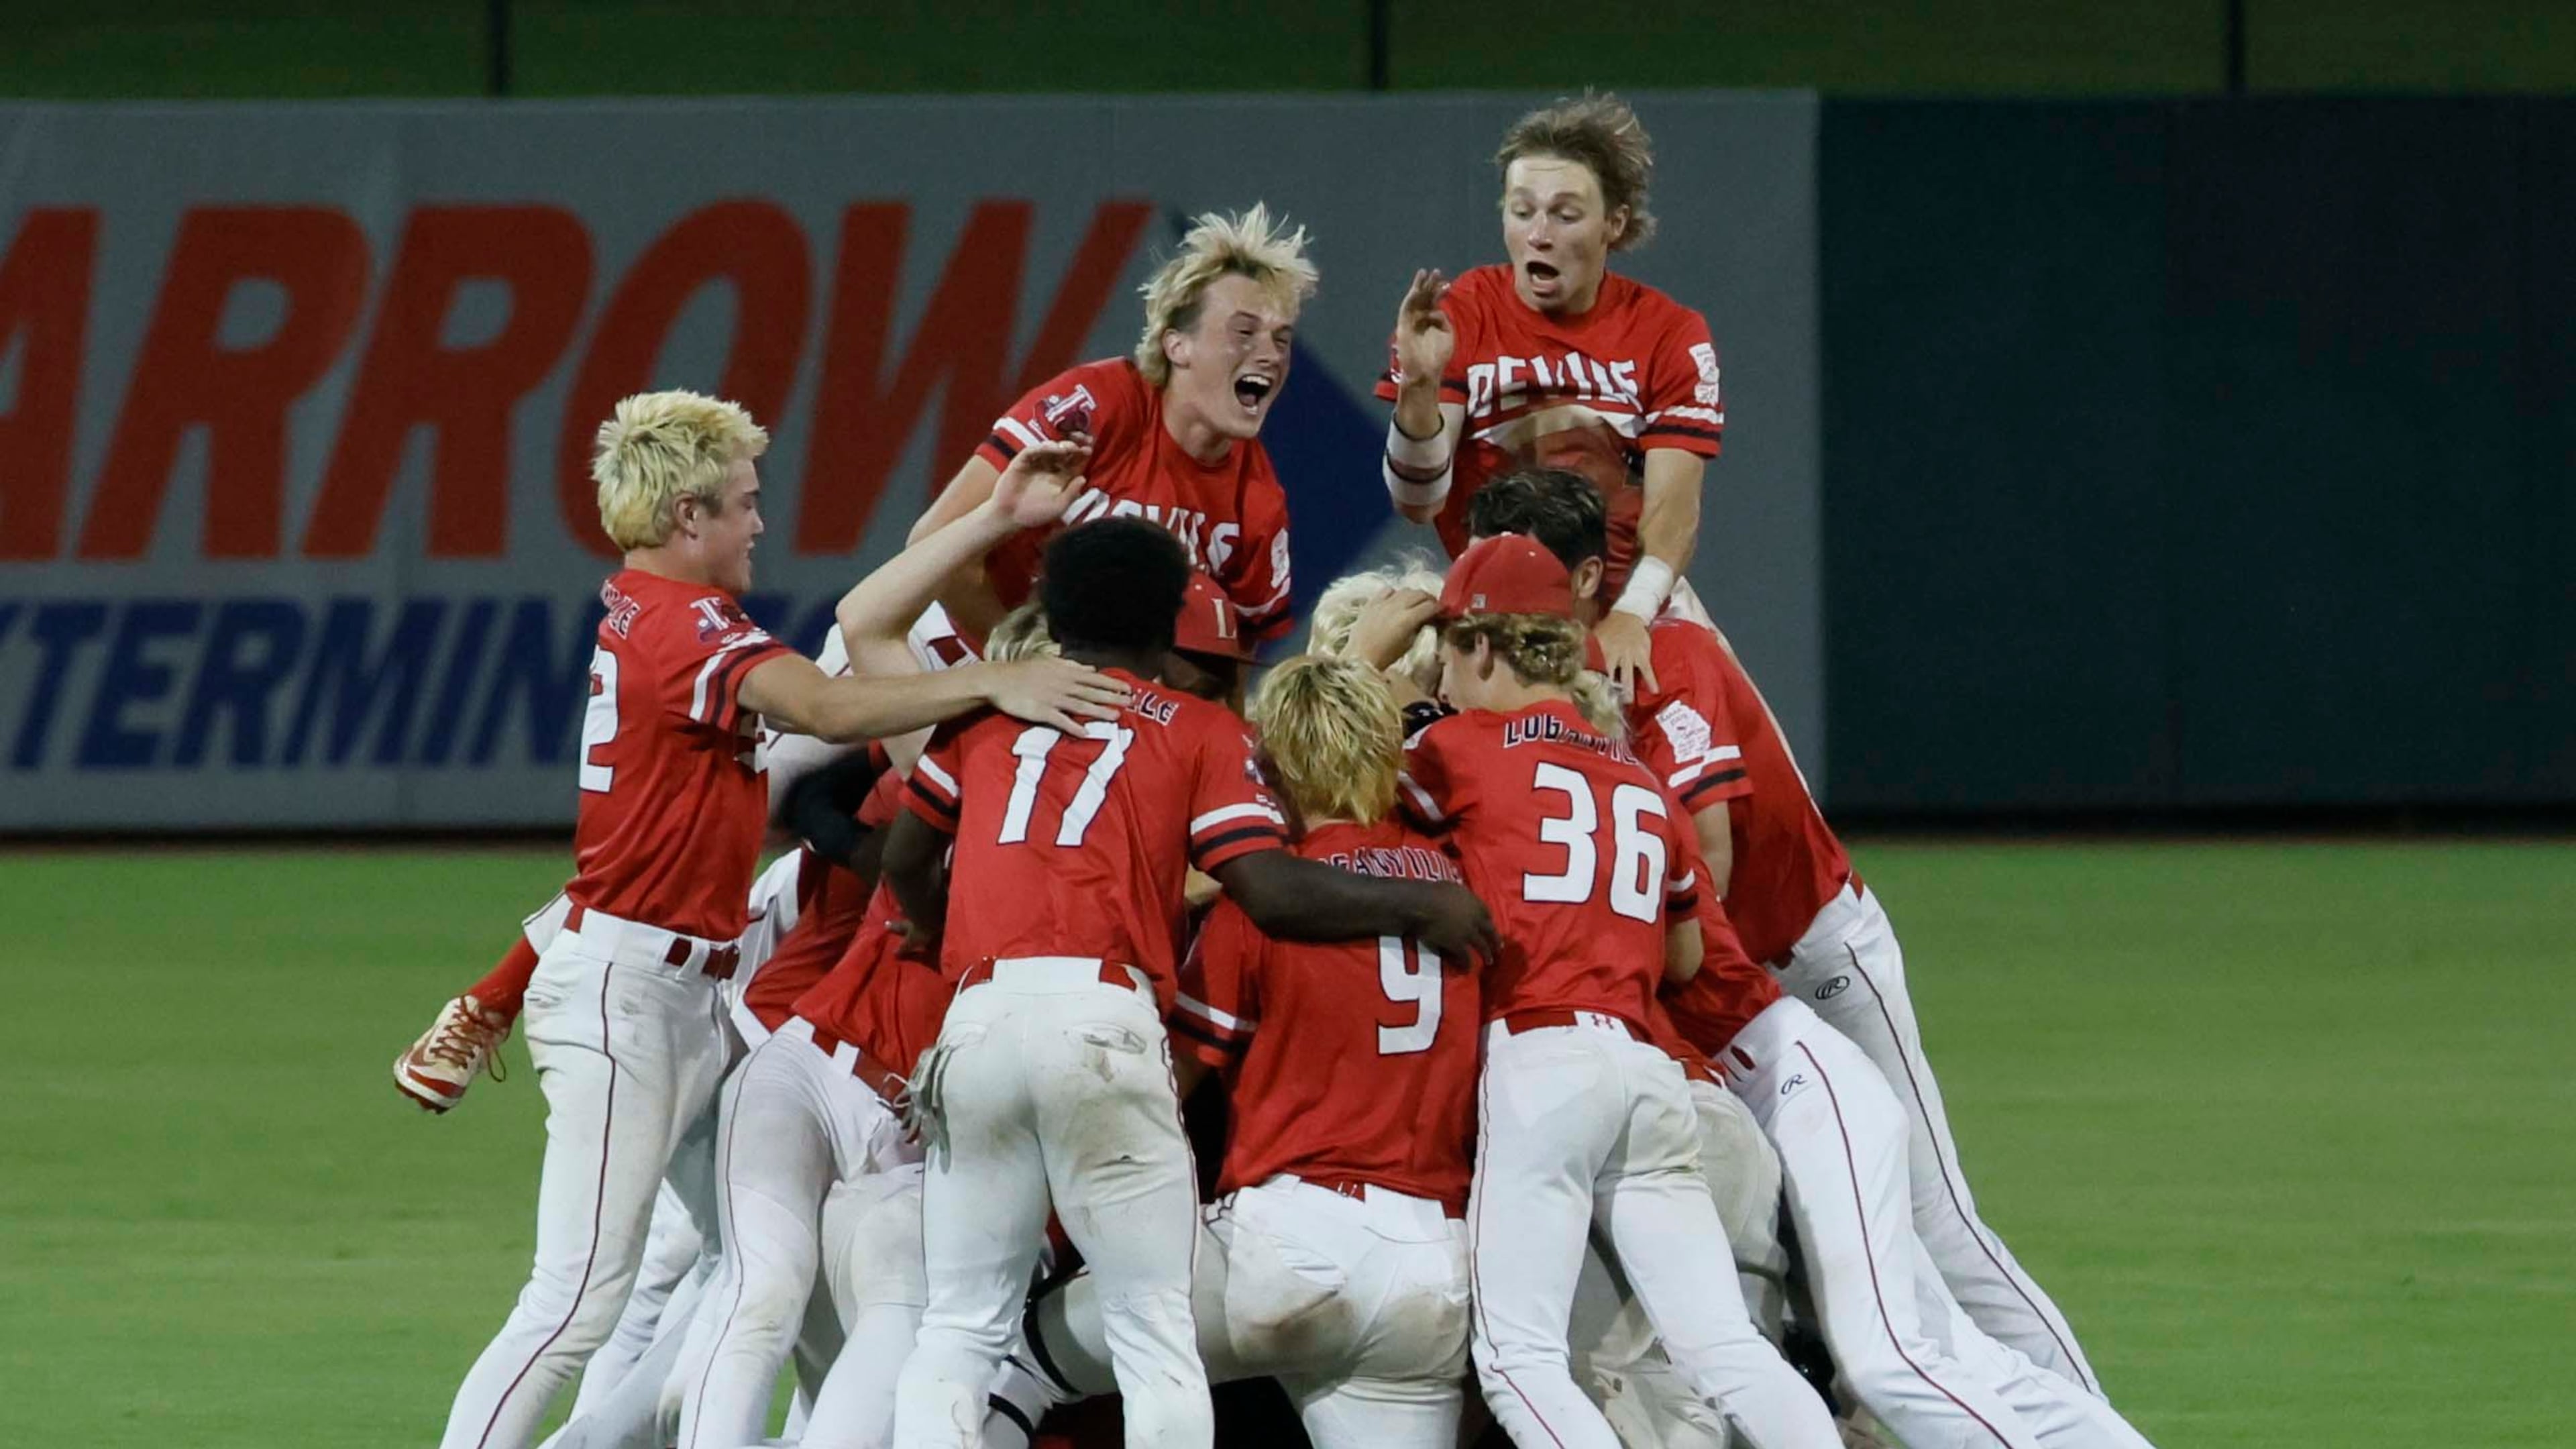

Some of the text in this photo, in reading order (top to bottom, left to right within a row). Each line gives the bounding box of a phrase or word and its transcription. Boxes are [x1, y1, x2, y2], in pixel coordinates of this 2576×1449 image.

[997, 720, 1134, 848] 17
[1522, 761, 1669, 925] 36
[1377, 935, 1444, 1055] 9
